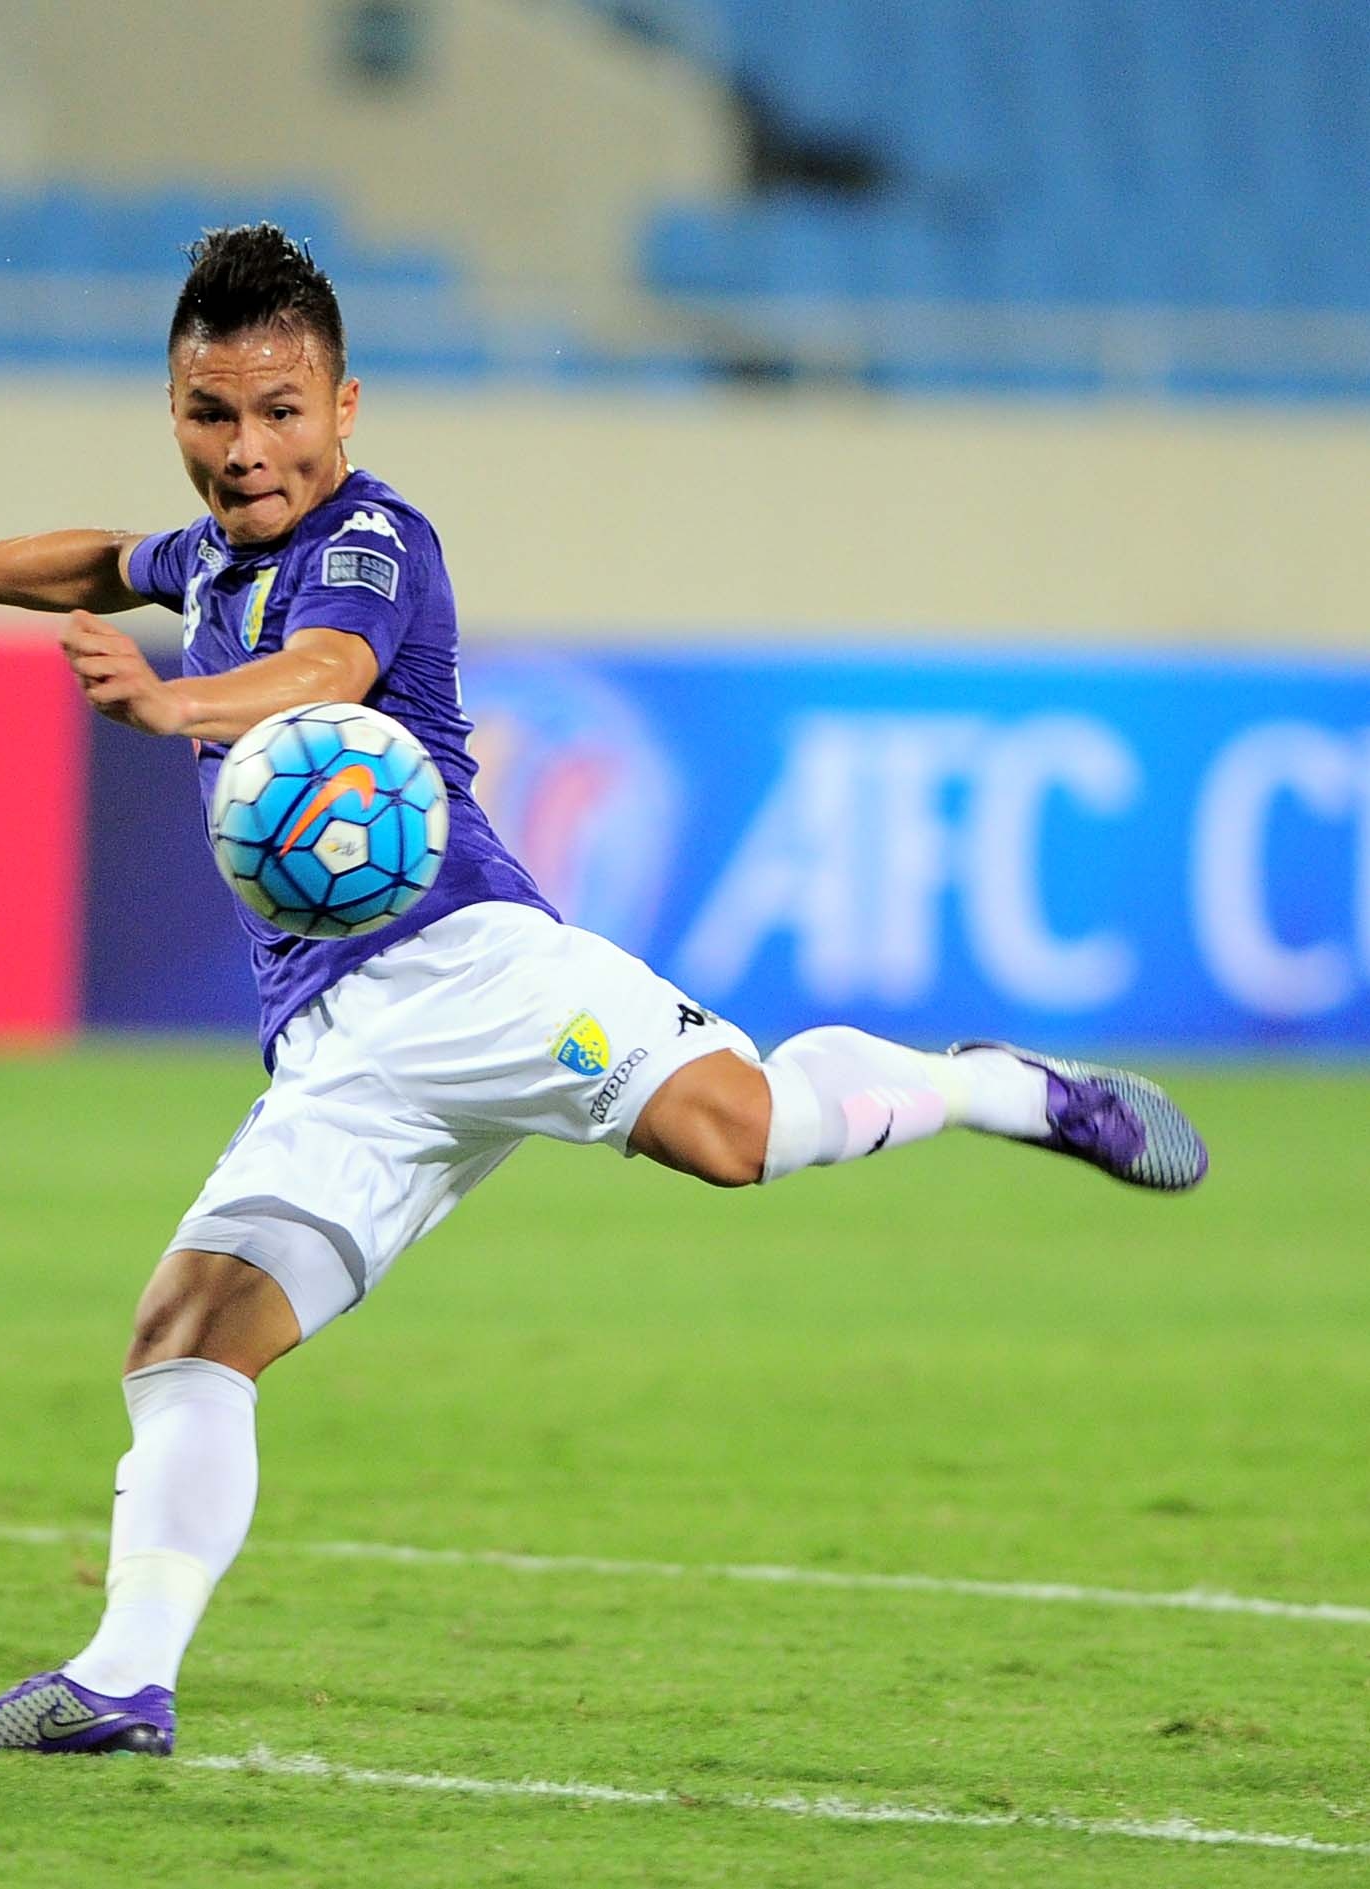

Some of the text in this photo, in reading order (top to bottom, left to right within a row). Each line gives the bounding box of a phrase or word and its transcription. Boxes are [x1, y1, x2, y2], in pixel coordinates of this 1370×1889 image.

[330, 553, 358, 567] ONE
[330, 567, 358, 580] ONE
[674, 706, 1370, 1018] AFC C
[590, 1047, 648, 1124] Kappa
